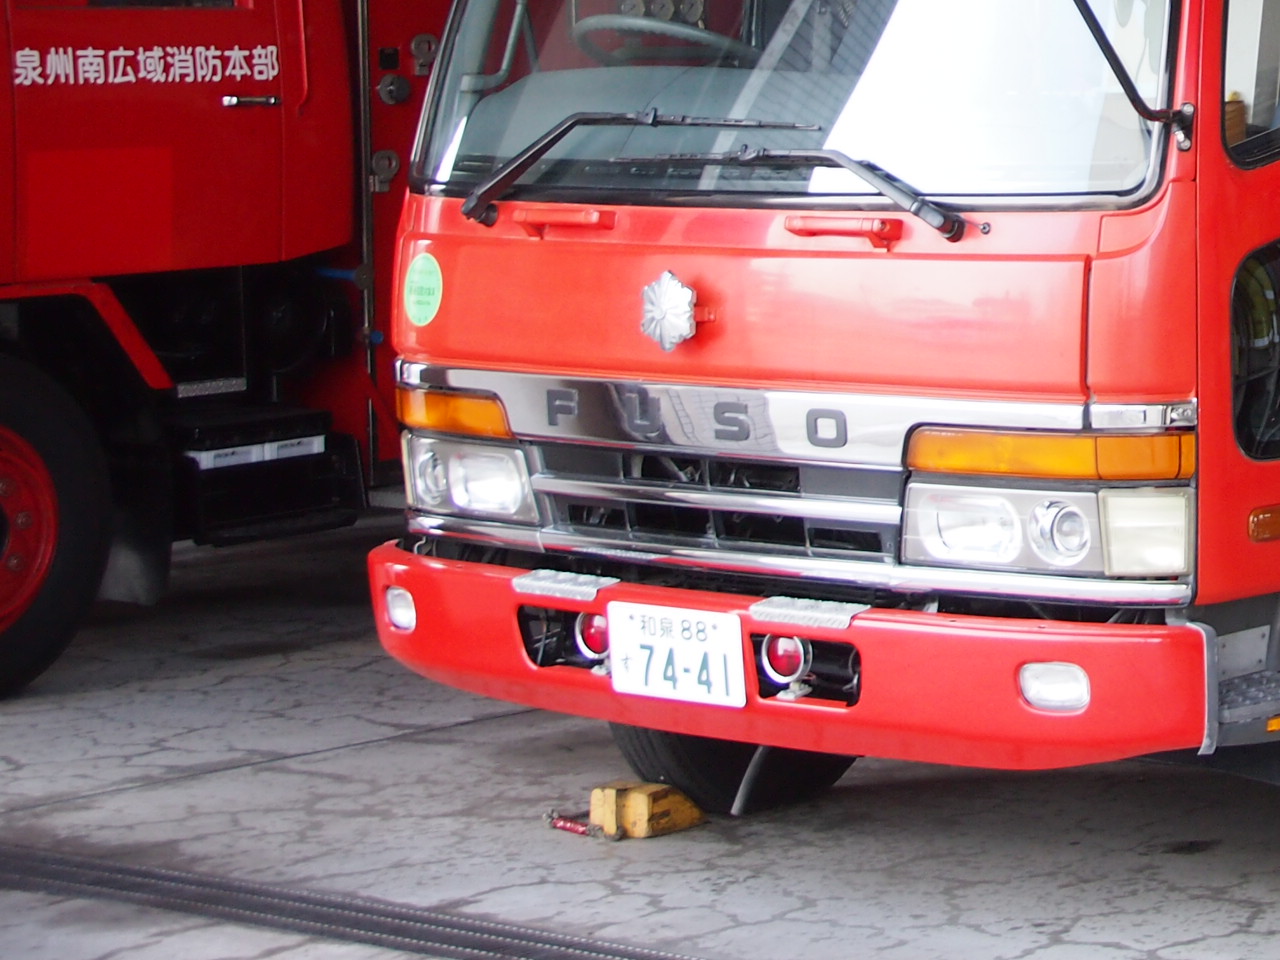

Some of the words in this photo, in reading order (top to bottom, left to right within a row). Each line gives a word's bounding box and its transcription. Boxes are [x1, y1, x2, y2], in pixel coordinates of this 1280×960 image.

[14, 44, 280, 86] 泉州南広域消防本部
[546, 389, 848, 448] FUSO
[639, 643, 730, 697] 74-41
